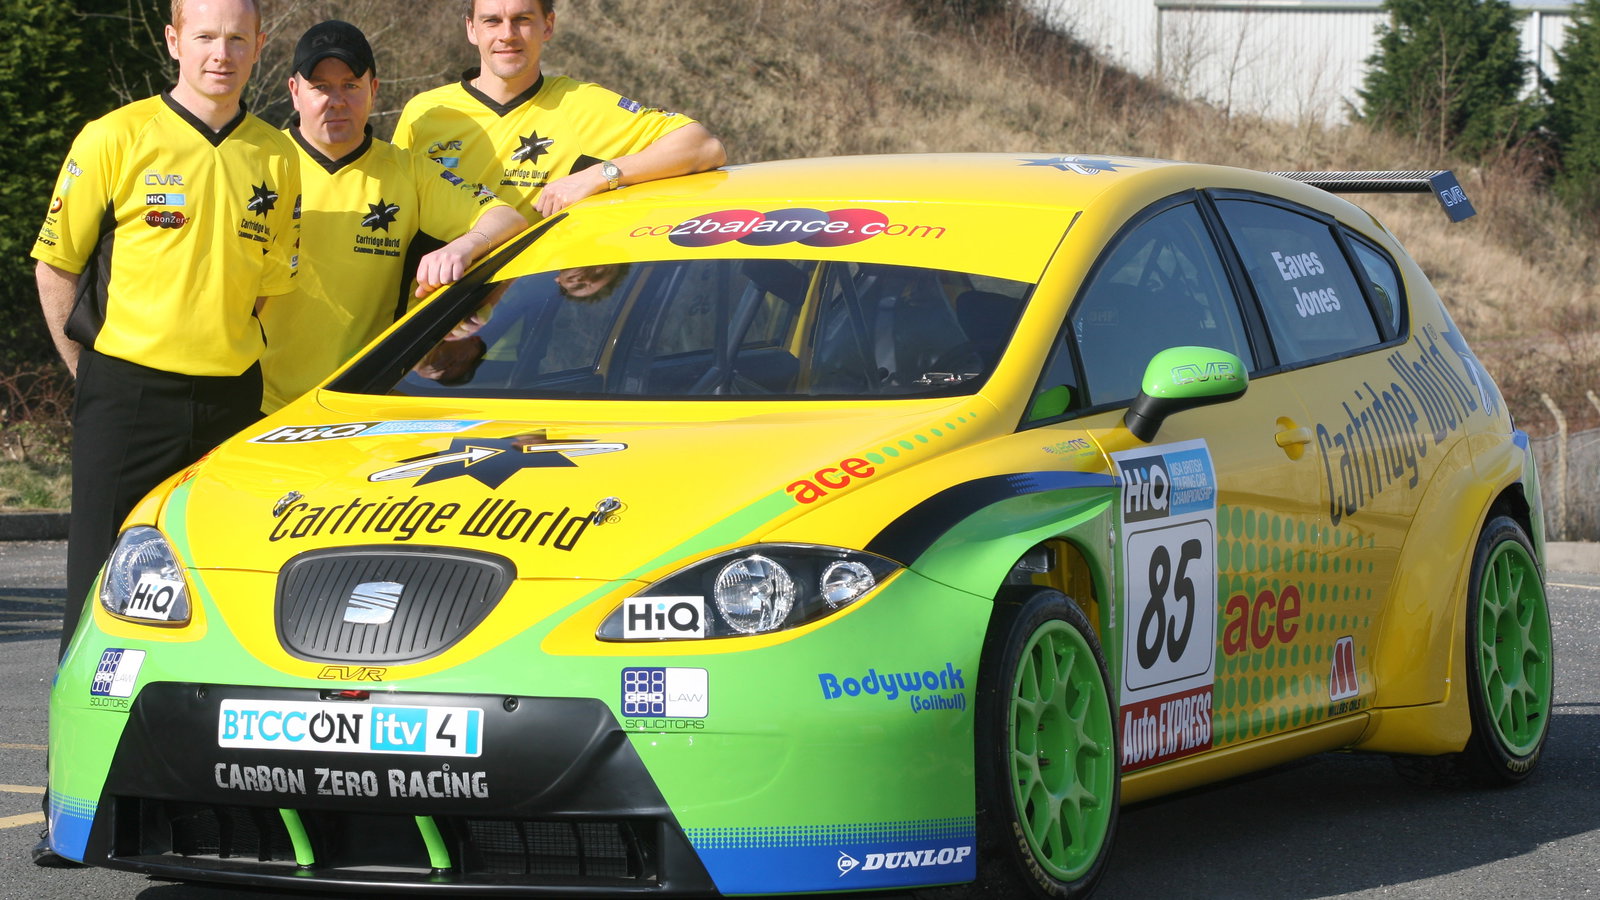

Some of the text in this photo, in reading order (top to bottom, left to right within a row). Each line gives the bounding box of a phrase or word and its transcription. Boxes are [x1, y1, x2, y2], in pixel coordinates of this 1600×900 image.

[428, 140, 463, 154] CVR
[145, 174, 184, 186] CVR
[147, 195, 165, 204] HiQ
[1440, 185, 1467, 207] CVR
[141, 213, 190, 224] CarbonZero
[629, 216, 947, 240] co2balance.com
[356, 234, 401, 248] Cartridge World
[1271, 250, 1325, 282] Eaves
[1294, 285, 1341, 318] Jones
[264, 424, 368, 441] HiQ
[1316, 326, 1478, 527] Cartridge World
[1182, 459, 1203, 475] BRITISH
[785, 457, 875, 505] ace
[1123, 464, 1169, 513] HiQ
[1173, 473, 1208, 490] TOURING CAR
[1173, 487, 1213, 506] CHAMPIONSHIP
[268, 496, 599, 552] Cartridge World
[129, 582, 174, 614] HiQ
[1136, 538, 1202, 670] 85
[628, 602, 700, 633] HiQ
[1223, 585, 1301, 656] ace
[317, 665, 388, 682] CVR
[817, 662, 966, 701] Bodywork
[89, 697, 129, 709] SOLICITORS
[669, 693, 704, 703] LAW
[910, 692, 966, 714] (Solihull)
[375, 712, 423, 746] itv
[435, 713, 457, 749] 4
[625, 719, 705, 730] SOLICITORS
[1121, 691, 1212, 766] Auto EXPRESS
[214, 762, 489, 799] CARBON ZERO RACING
[861, 846, 972, 871] DUNLOP
